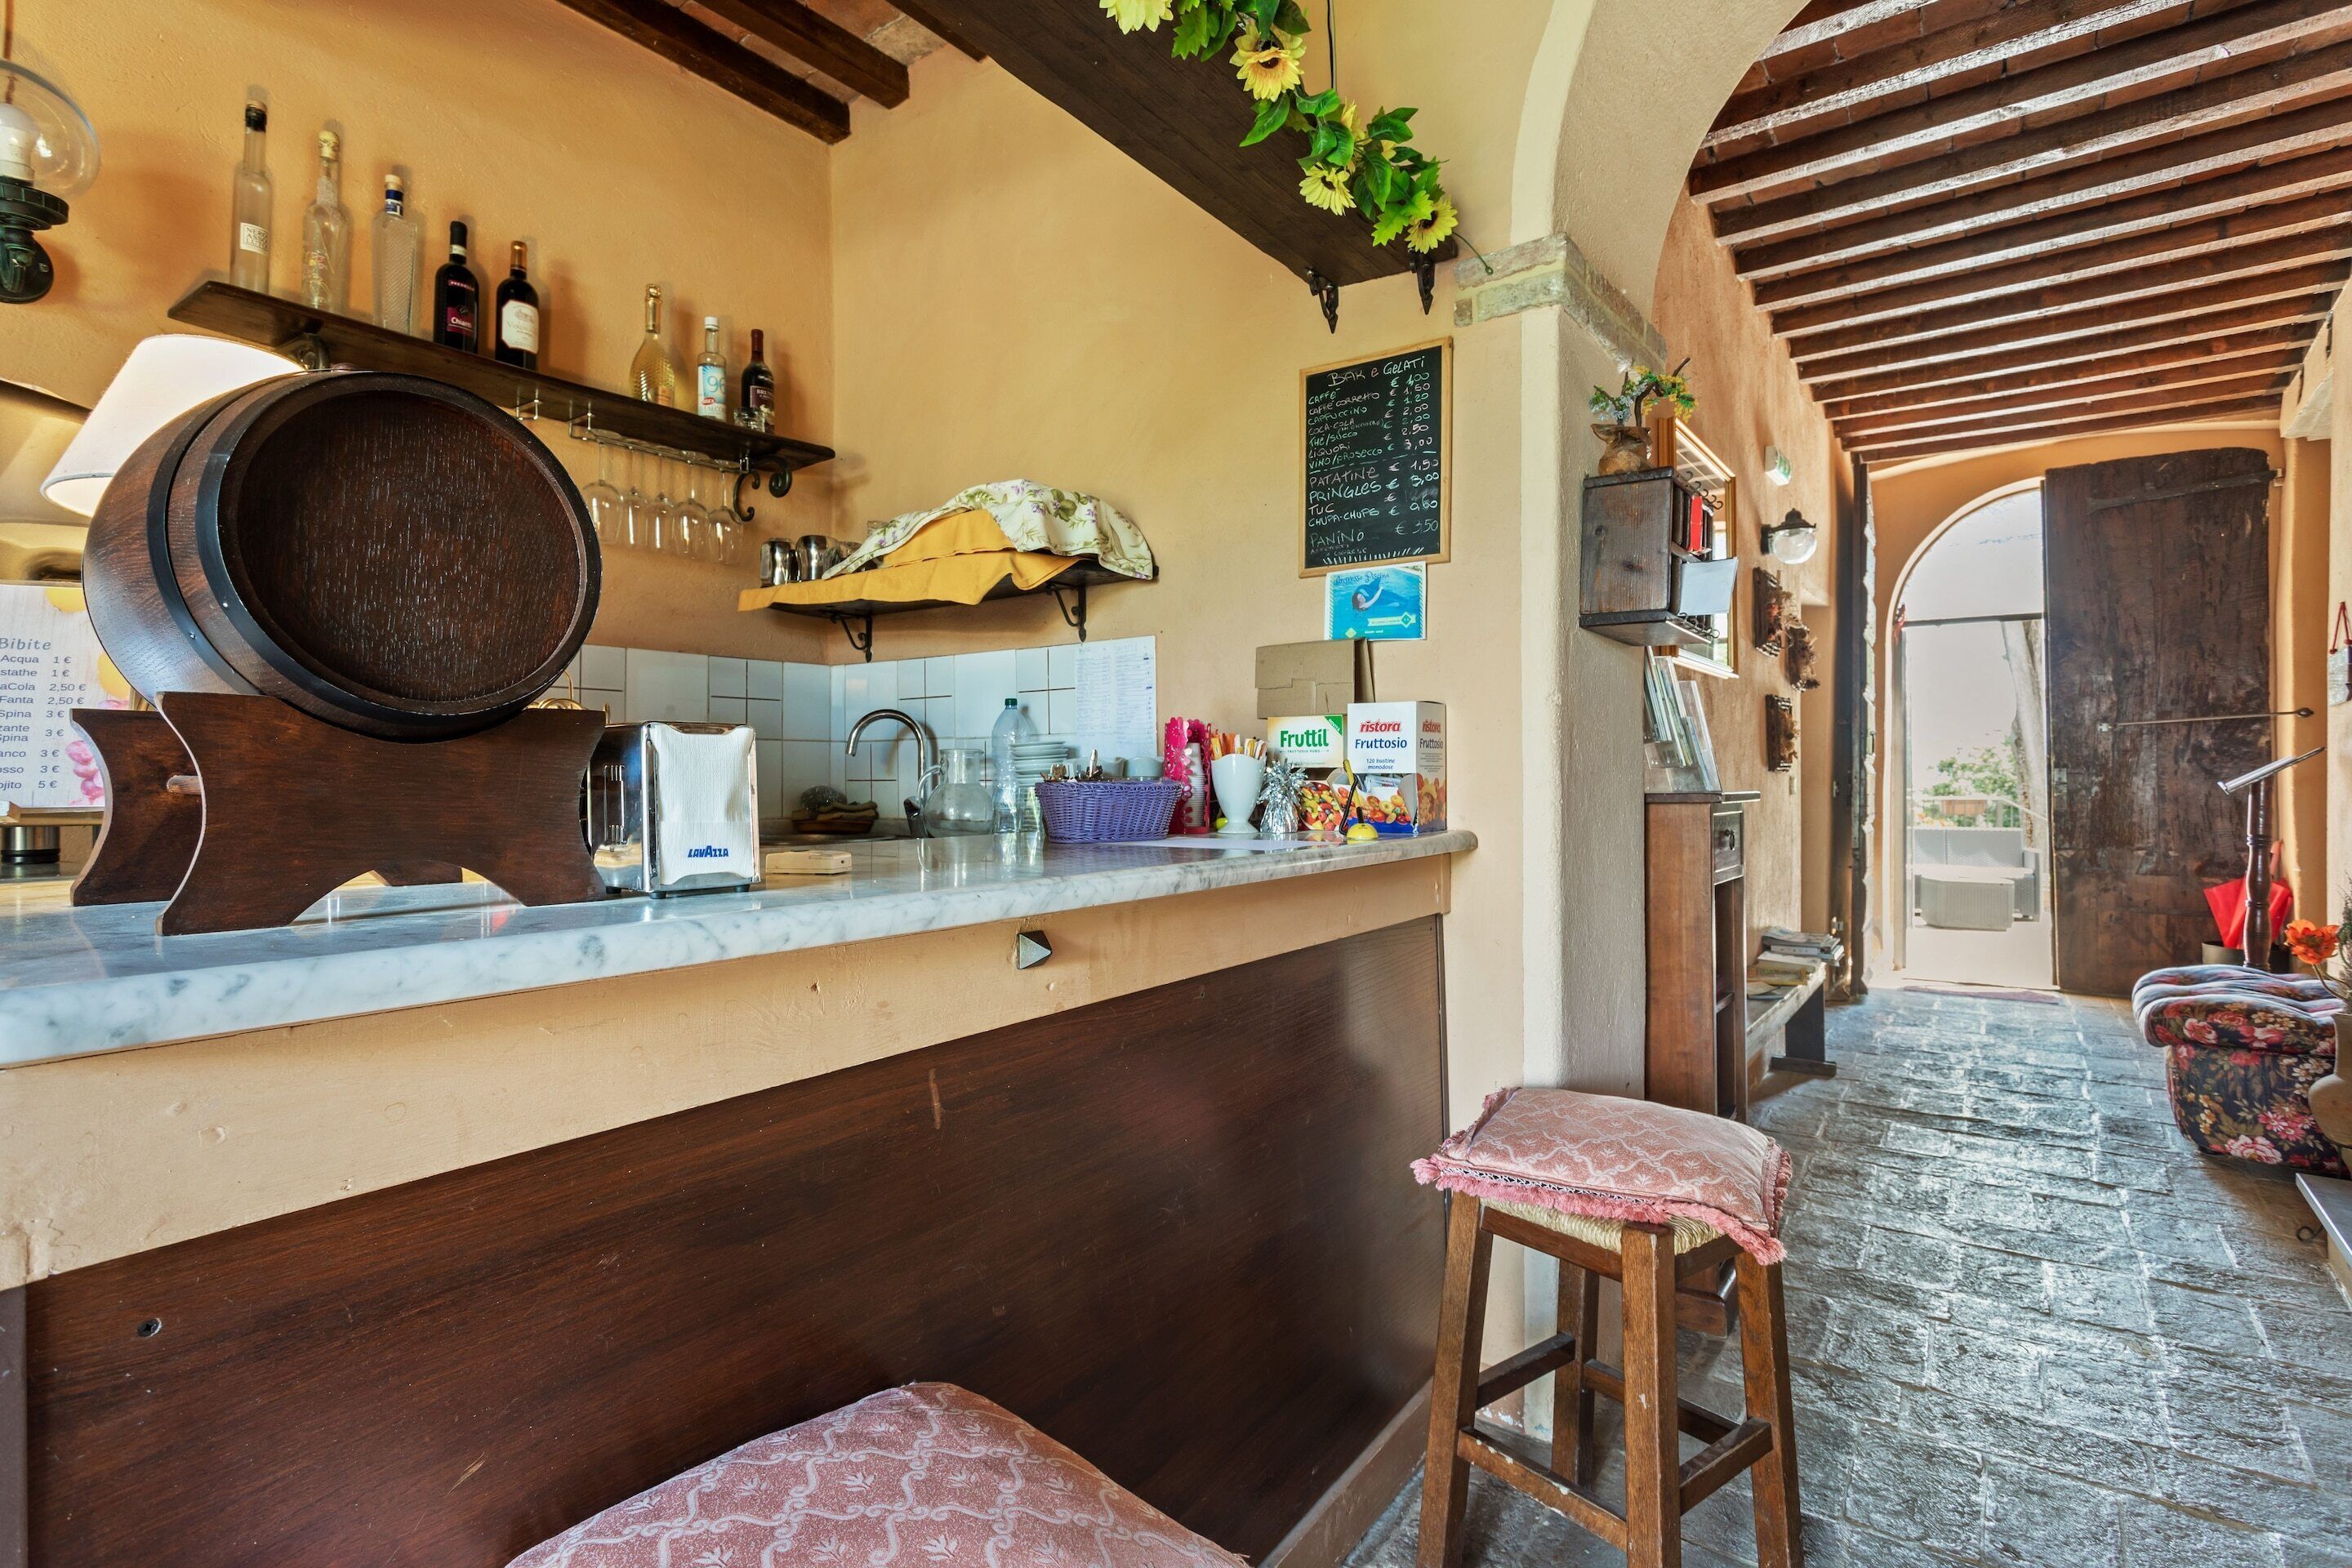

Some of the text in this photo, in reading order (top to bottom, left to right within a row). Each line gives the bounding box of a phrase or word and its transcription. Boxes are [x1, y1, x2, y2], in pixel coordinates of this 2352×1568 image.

[707, 376, 725, 394] 96
[1390, 376, 1400, 388] €
[1405, 372, 1430, 386] 1,00
[1389, 388, 1396, 396] €
[1386, 399, 1395, 407] €
[1404, 392, 1429, 404] 1,20
[1308, 403, 1429, 435] COCA-COLA € 2,00
[1383, 421, 1392, 429] €
[1402, 413, 1430, 425] 2,00
[1383, 433, 1392, 441] €
[1401, 423, 1429, 435] 2,50
[1403, 436, 1433, 450] 3,00
[1388, 461, 1400, 472] €
[1410, 459, 1439, 471] 1,50
[1386, 478, 1400, 489] €
[1410, 472, 1440, 487] 3,00
[1308, 492, 1396, 516] TUC €
[1308, 507, 1380, 528] CHUPA-CHUPS
[1388, 506, 1400, 516] €
[1395, 519, 1409, 536] €
[0, 637, 51, 651] Bibite
[1, 655, 39, 664] Acqua
[49, 684, 75, 692] 2,50
[78, 684, 87, 692] €
[0, 696, 33, 704] Fanta
[0, 710, 32, 719] Spina
[1359, 719, 1402, 733] ristora
[1422, 719, 1441, 733] ristora
[0, 734, 29, 743] pina
[1280, 728, 1330, 747] Fruttil
[1355, 737, 1408, 750] Fruttosio
[1419, 738, 1444, 750] Fruttosio
[688, 845, 729, 858] LAVAZZA
